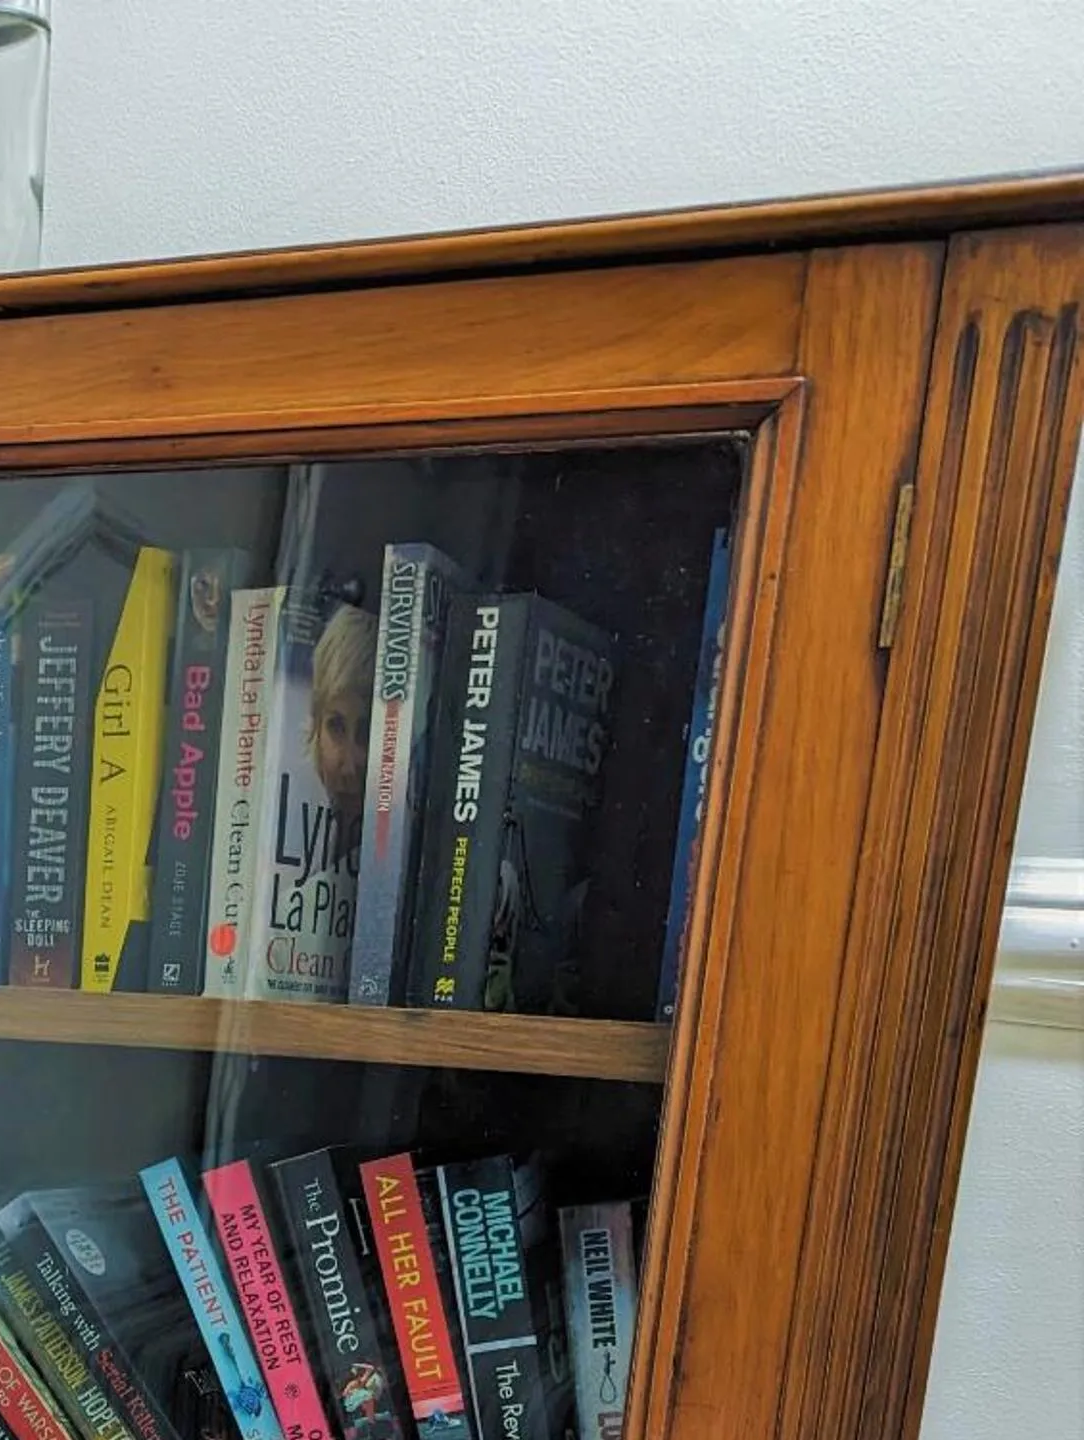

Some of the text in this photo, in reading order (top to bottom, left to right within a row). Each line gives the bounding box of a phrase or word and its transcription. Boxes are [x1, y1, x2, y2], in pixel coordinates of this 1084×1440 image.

[234, 603, 271, 788] Lynda La Plante
[381, 561, 417, 703] SURVIVORS
[533, 627, 614, 713] PETER
[33, 634, 79, 776] JEFFERY
[99, 663, 134, 786] Girl A
[171, 665, 212, 842] Bad Apple
[452, 604, 501, 824] PETER JAMES
[520, 698, 608, 776] JAMES
[24, 786, 70, 905] DEAVER
[99, 803, 119, 930] ABIGAIL DEAN
[226, 800, 251, 876] Clean
[269, 873, 305, 933] La
[443, 835, 470, 964] PERFECT PEOPLE
[15, 916, 70, 932] SLEEPING
[157, 1177, 229, 1328] THE PATIENT
[220, 1212, 281, 1371] AND RELAXATION
[240, 1203, 302, 1366] MY YEAR OF REST
[302, 1176, 360, 1354] The Promise
[374, 1172, 444, 1381] ALL HER FAULT
[450, 1187, 498, 1321] CONNELLY
[481, 1188, 525, 1311] MICHAEL
[579, 1228, 617, 1350] NEIL WHITE
[0, 1268, 39, 1320] JAMES
[31, 1311, 90, 1397] PATTERSON
[78, 1384, 115, 1435] HOPE
[34, 1250, 79, 1317] Talking
[72, 1314, 102, 1352] with
[95, 1347, 128, 1396] Serial
[494, 1360, 521, 1400] The
